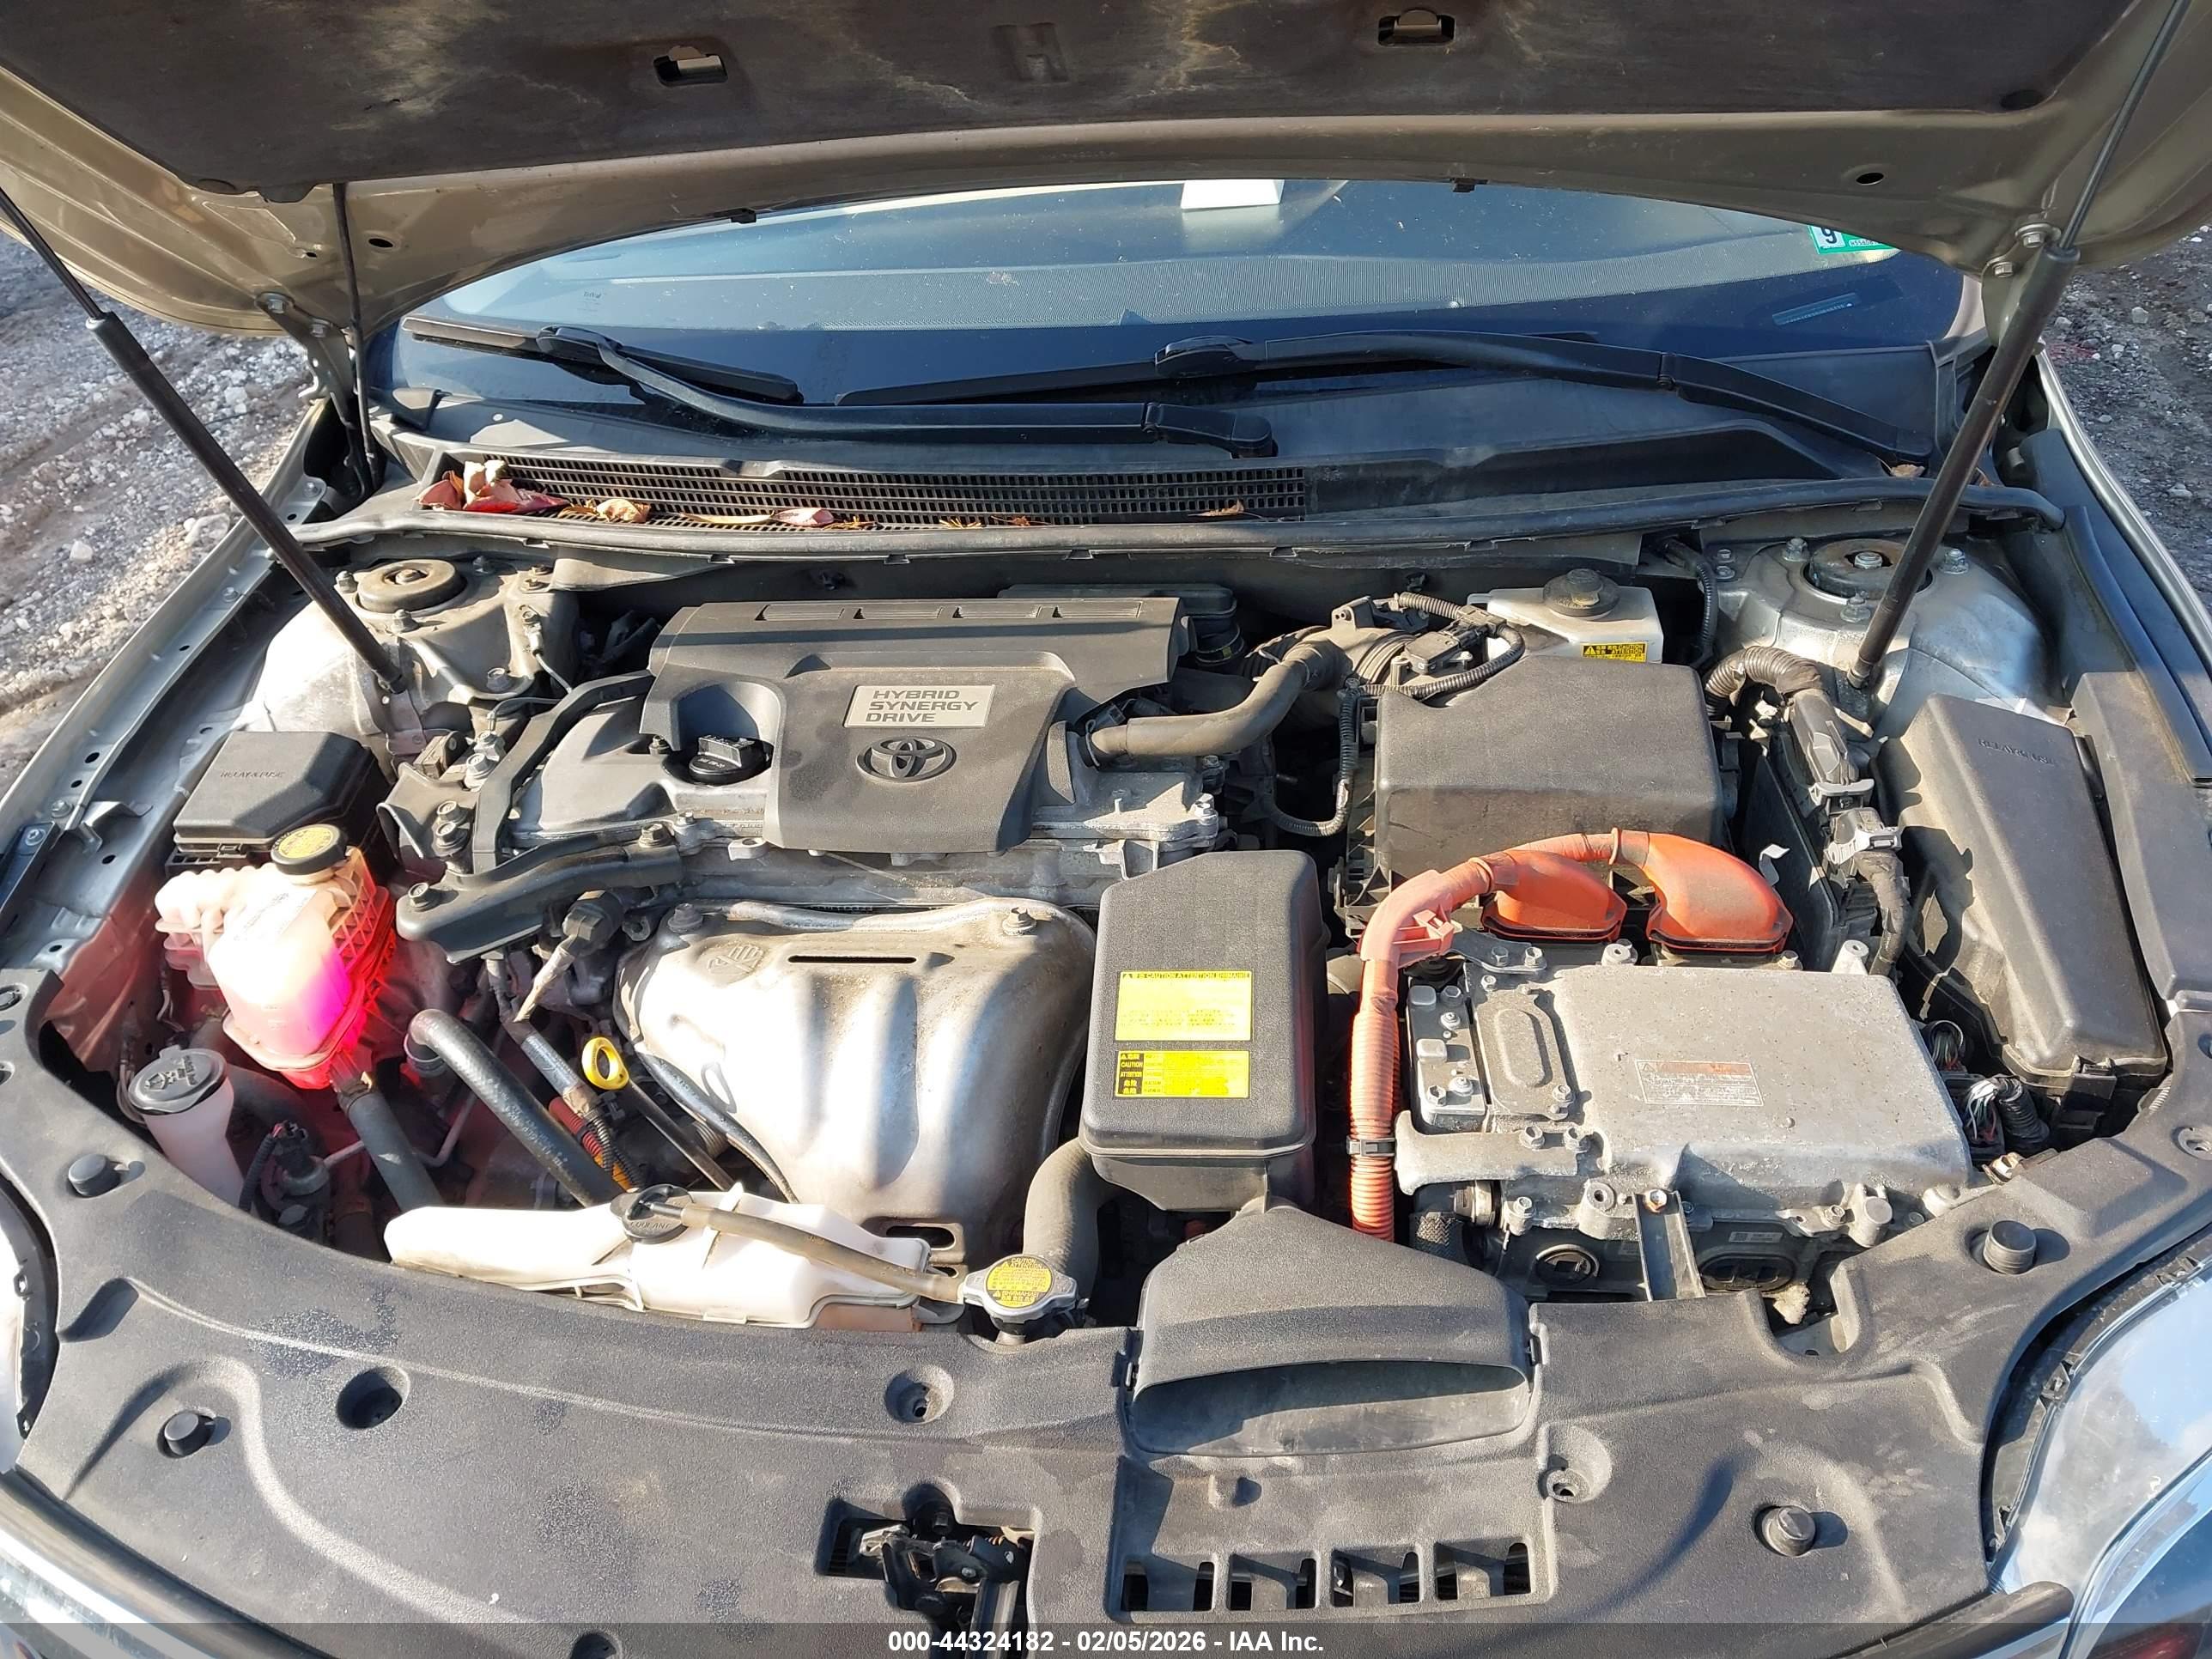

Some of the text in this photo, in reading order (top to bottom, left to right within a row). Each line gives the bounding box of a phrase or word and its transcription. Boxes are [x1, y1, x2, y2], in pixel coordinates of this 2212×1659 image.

[872, 690, 960, 700] HYBRID
[868, 701, 979, 711] SYNERGY
[866, 713, 937, 723] DRIVE
[630, 1221, 671, 1230] COOLANT
